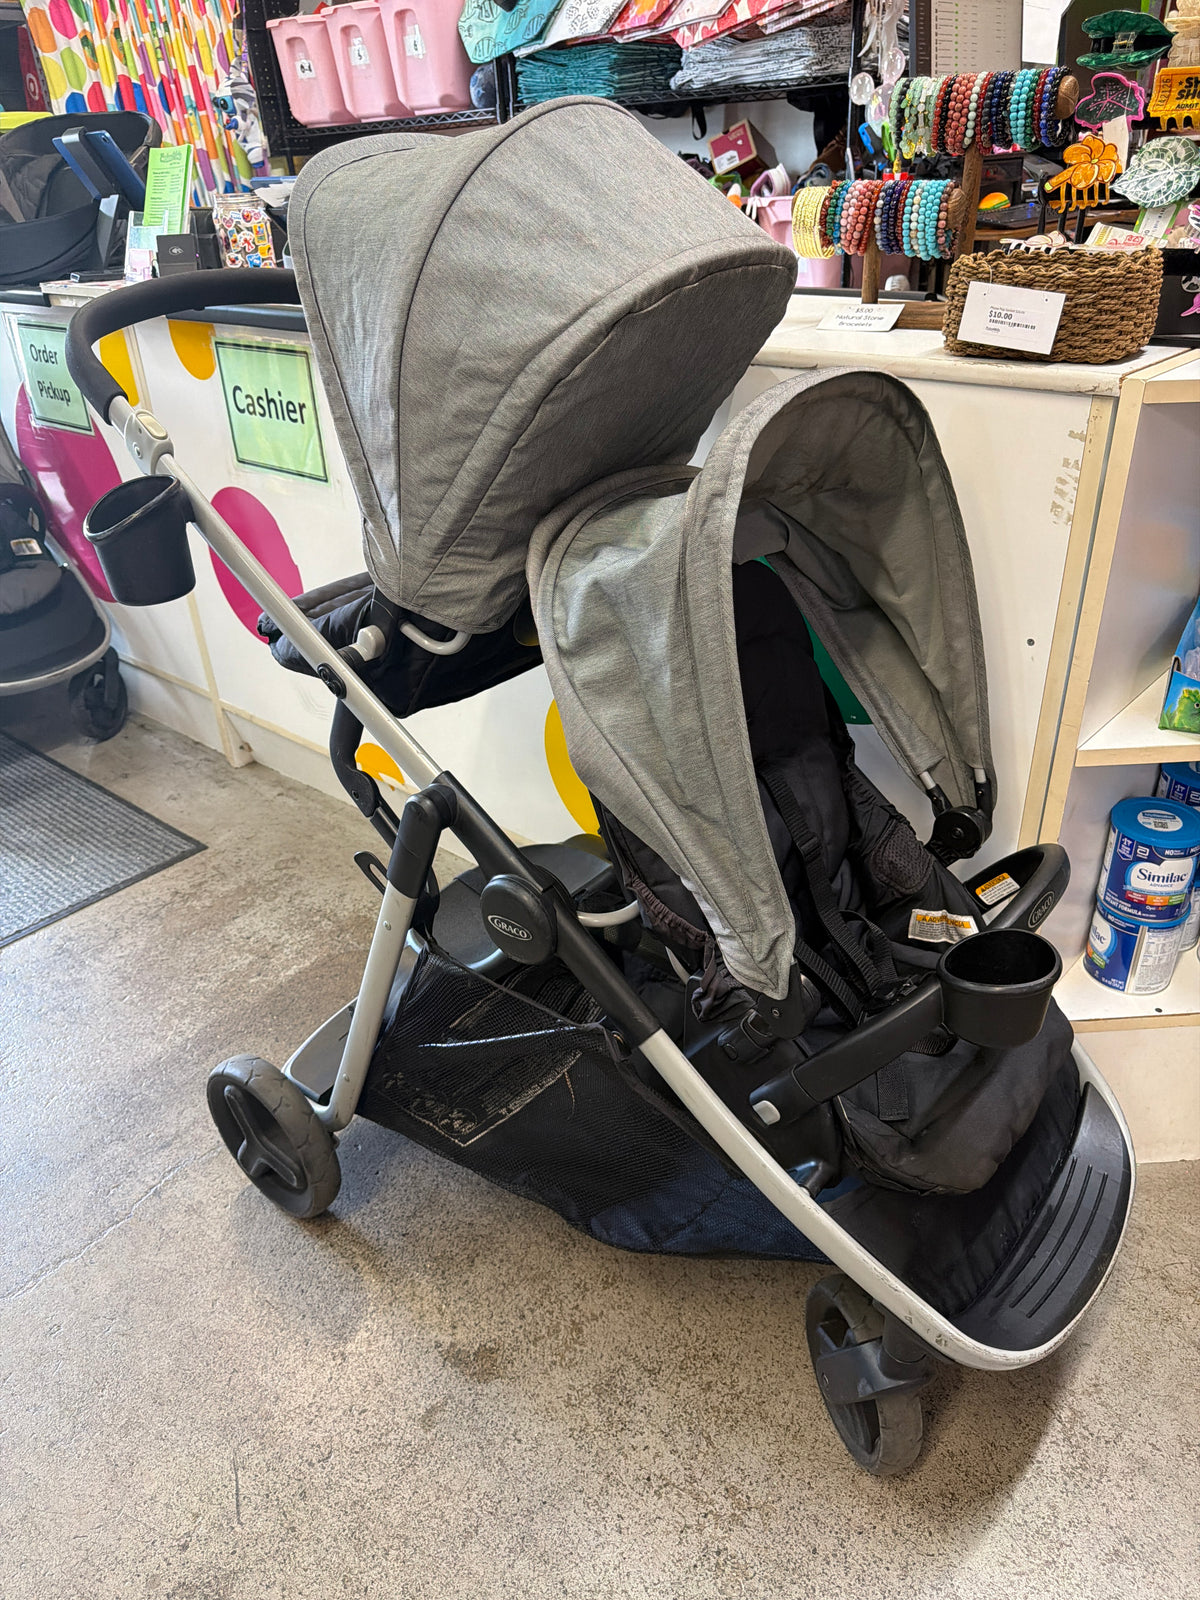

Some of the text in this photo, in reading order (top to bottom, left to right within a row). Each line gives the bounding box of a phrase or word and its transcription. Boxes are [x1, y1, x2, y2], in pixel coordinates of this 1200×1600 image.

[989, 310, 1013, 321] $10.00
[30, 344, 58, 365] Order
[37, 380, 71, 407] Pickup
[232, 385, 306, 425] Cashier
[1137, 867, 1187, 884] Similac
[1118, 903, 1142, 916] FORMULA
[493, 918, 527, 938] GRACO
